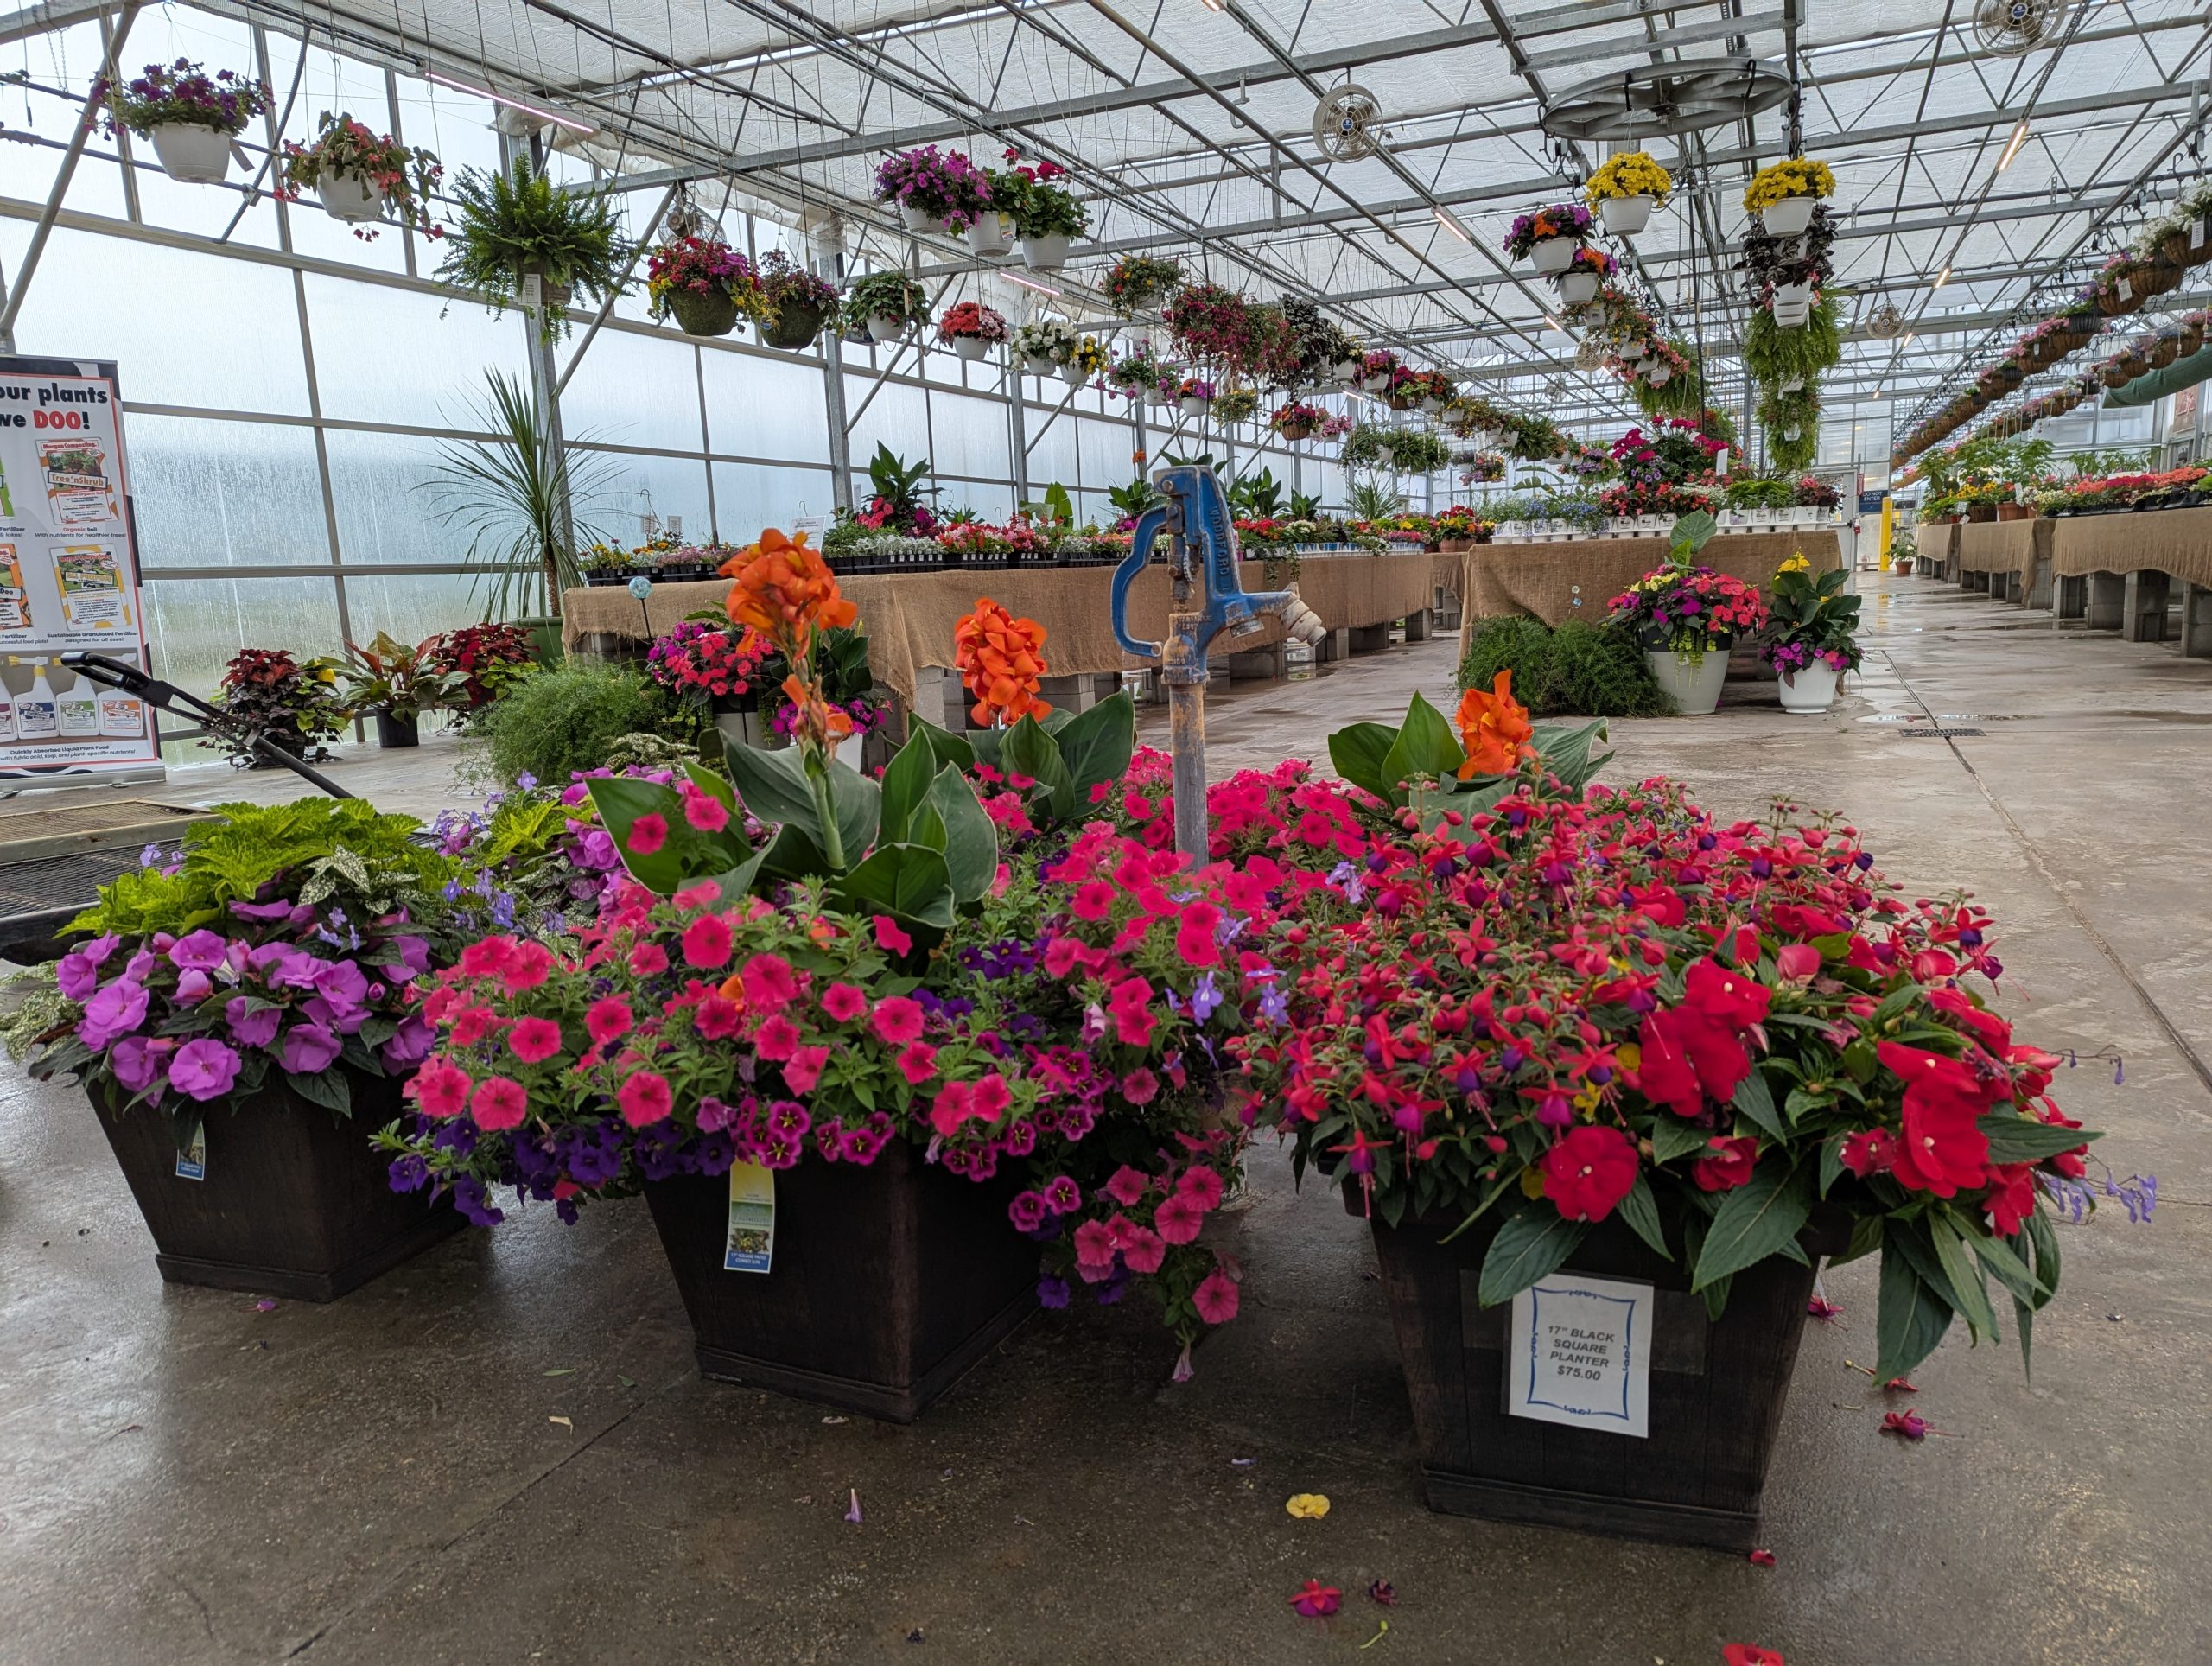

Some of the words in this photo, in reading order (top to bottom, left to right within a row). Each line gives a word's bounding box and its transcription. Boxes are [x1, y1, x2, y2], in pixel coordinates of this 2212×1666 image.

[38, 383, 108, 406] plants
[34, 410, 90, 429] DOO!
[1210, 505, 1230, 575] WOODFORD
[1548, 1326, 1568, 1335] 17"
[1570, 1328, 1615, 1343] BLACK
[1554, 1339, 1608, 1355] SQUARE
[1550, 1351, 1610, 1368] PLANTER
[1557, 1365, 1601, 1381] $75.00
